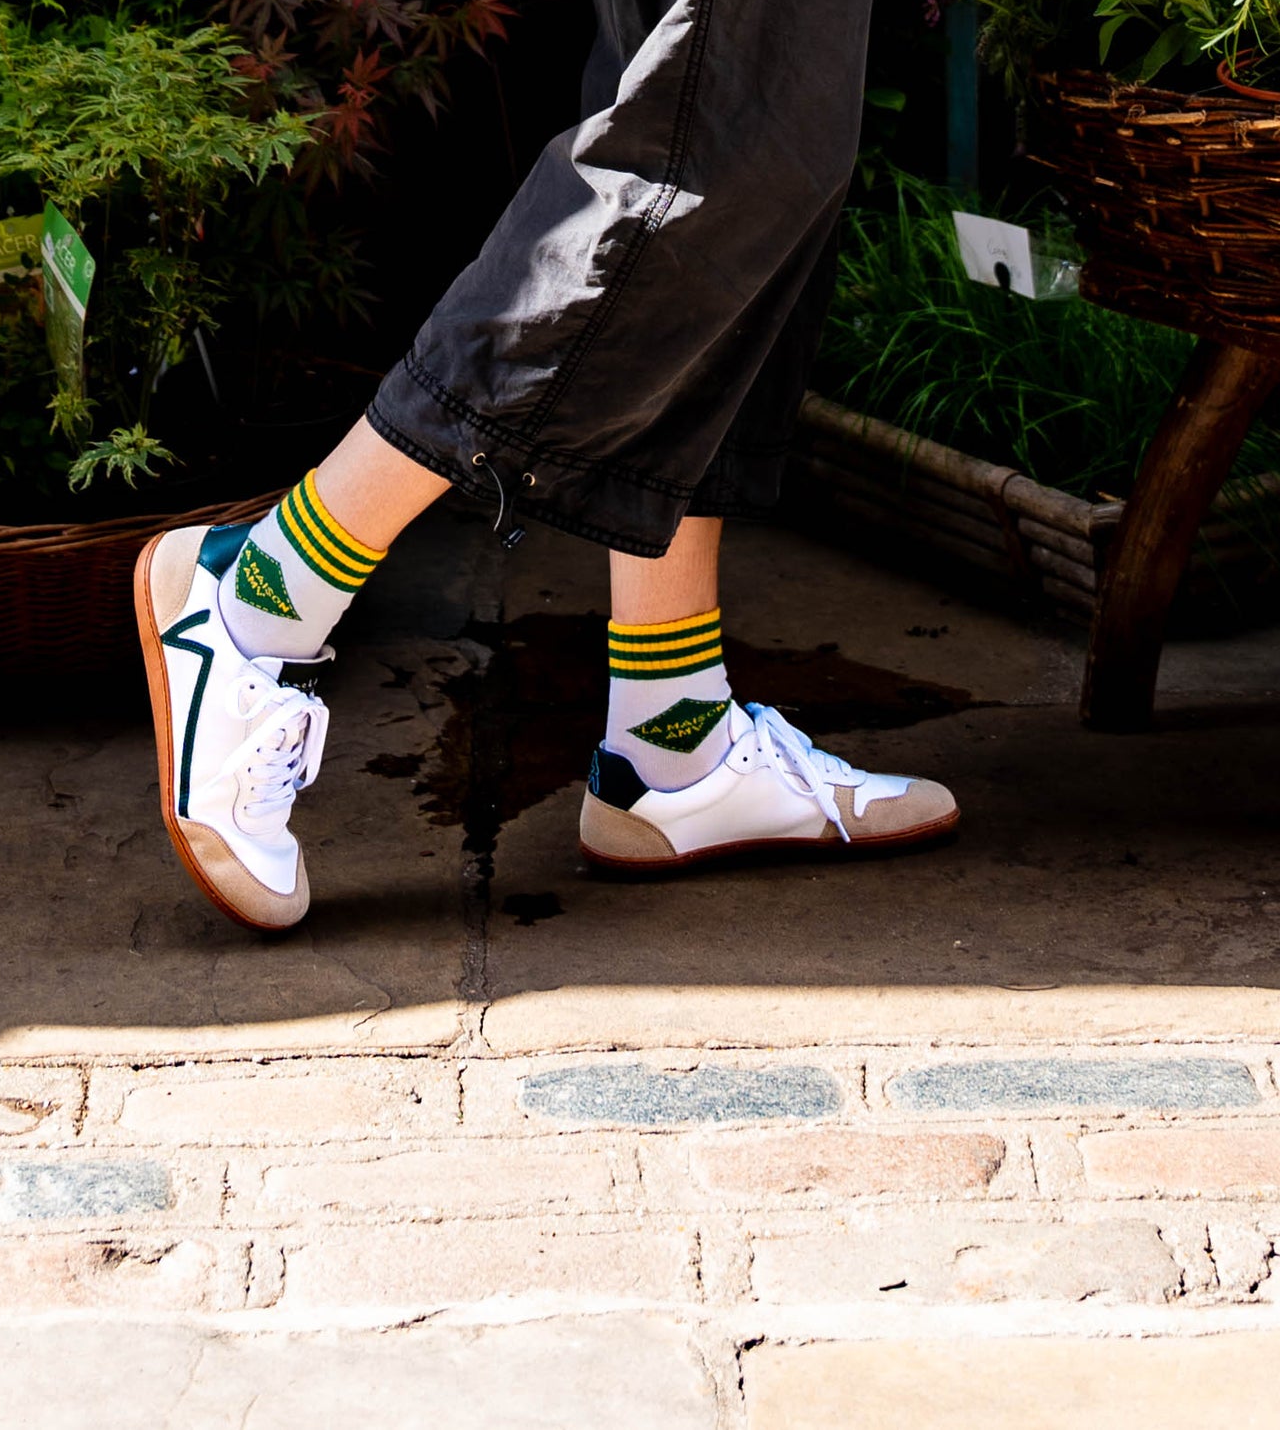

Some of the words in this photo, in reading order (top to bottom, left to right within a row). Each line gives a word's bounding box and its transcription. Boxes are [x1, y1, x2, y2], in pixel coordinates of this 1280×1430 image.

[249, 561, 291, 613] MAISON
[641, 723, 662, 735] LA
[666, 702, 726, 731] MAISON
